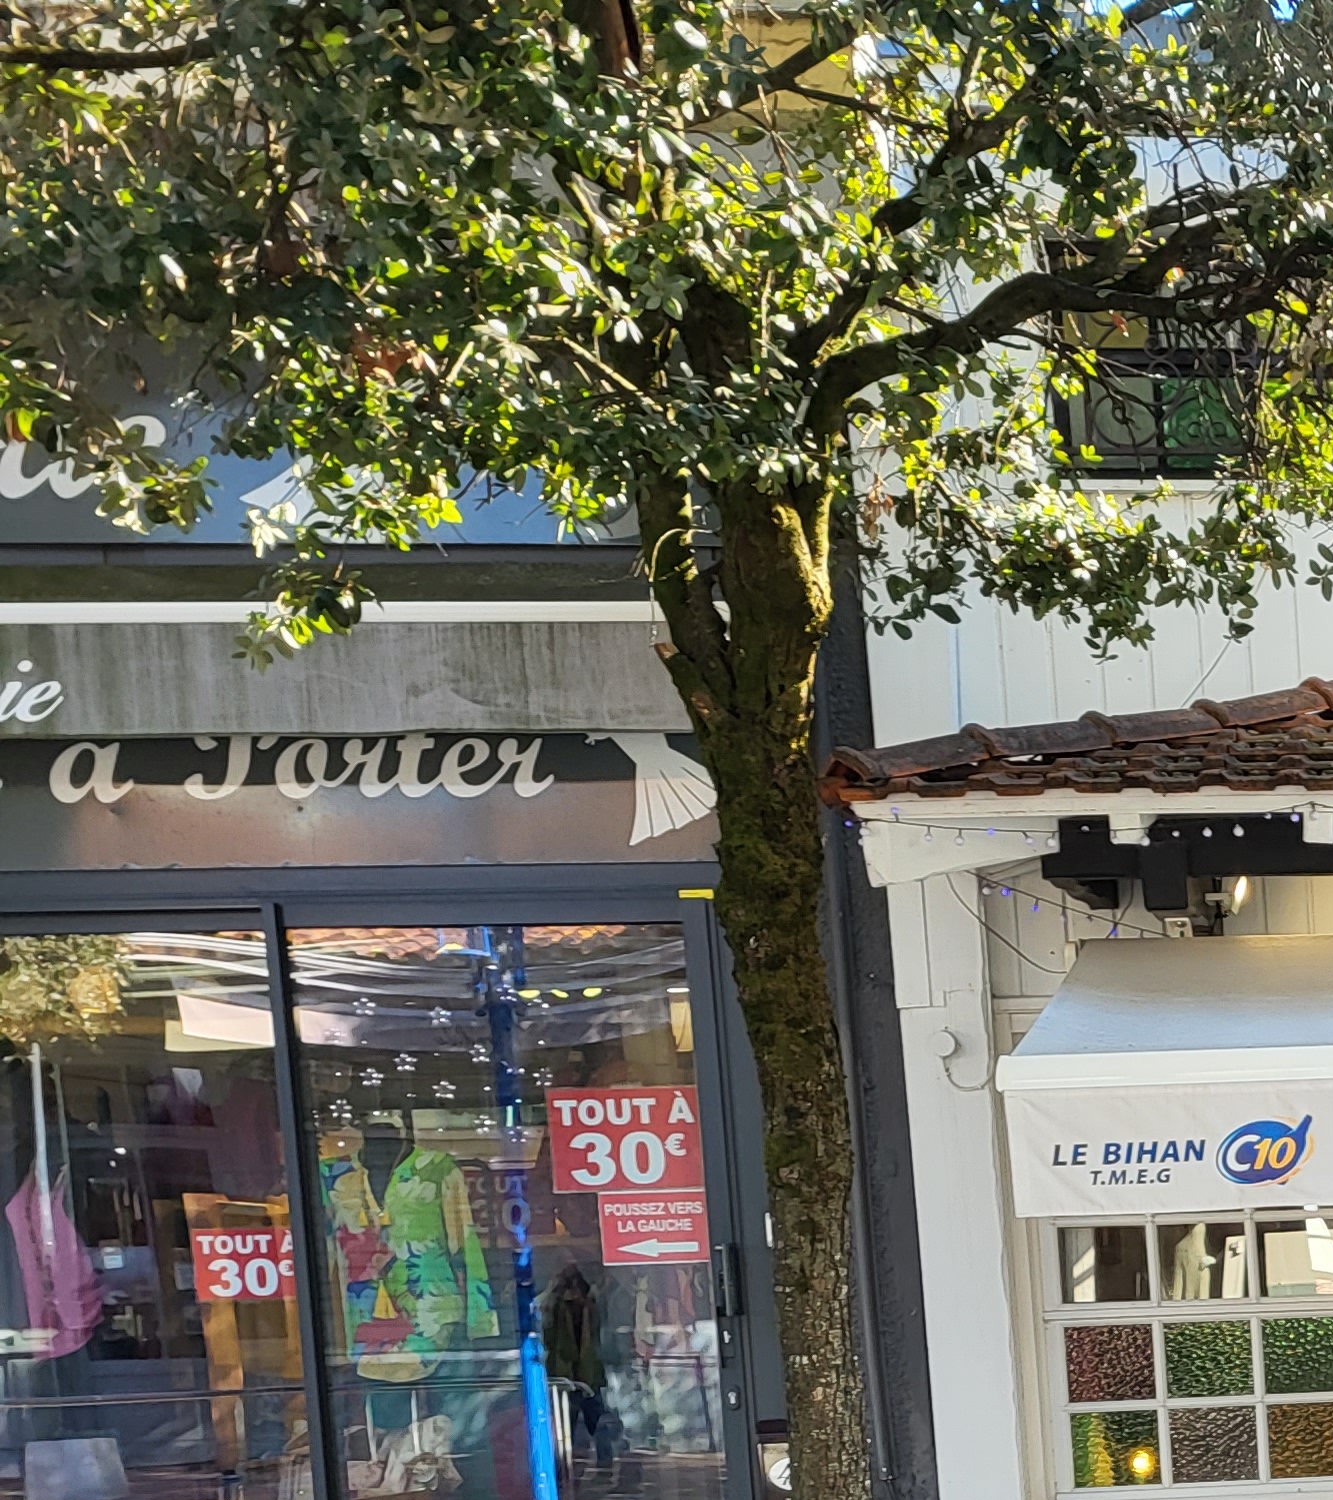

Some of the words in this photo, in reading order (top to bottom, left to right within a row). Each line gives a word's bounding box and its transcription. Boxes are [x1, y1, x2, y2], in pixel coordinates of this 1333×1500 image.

[552, 1098, 657, 1127] TOUT
[1052, 1144, 1088, 1166] LE
[1102, 1139, 1206, 1165] BIHAN
[604, 1203, 664, 1217] POUSSEZ
[667, 1201, 703, 1214] VERS
[617, 1220, 635, 1233] LA
[638, 1218, 693, 1232] GAUCHE
[195, 1234, 273, 1255] TOUT
